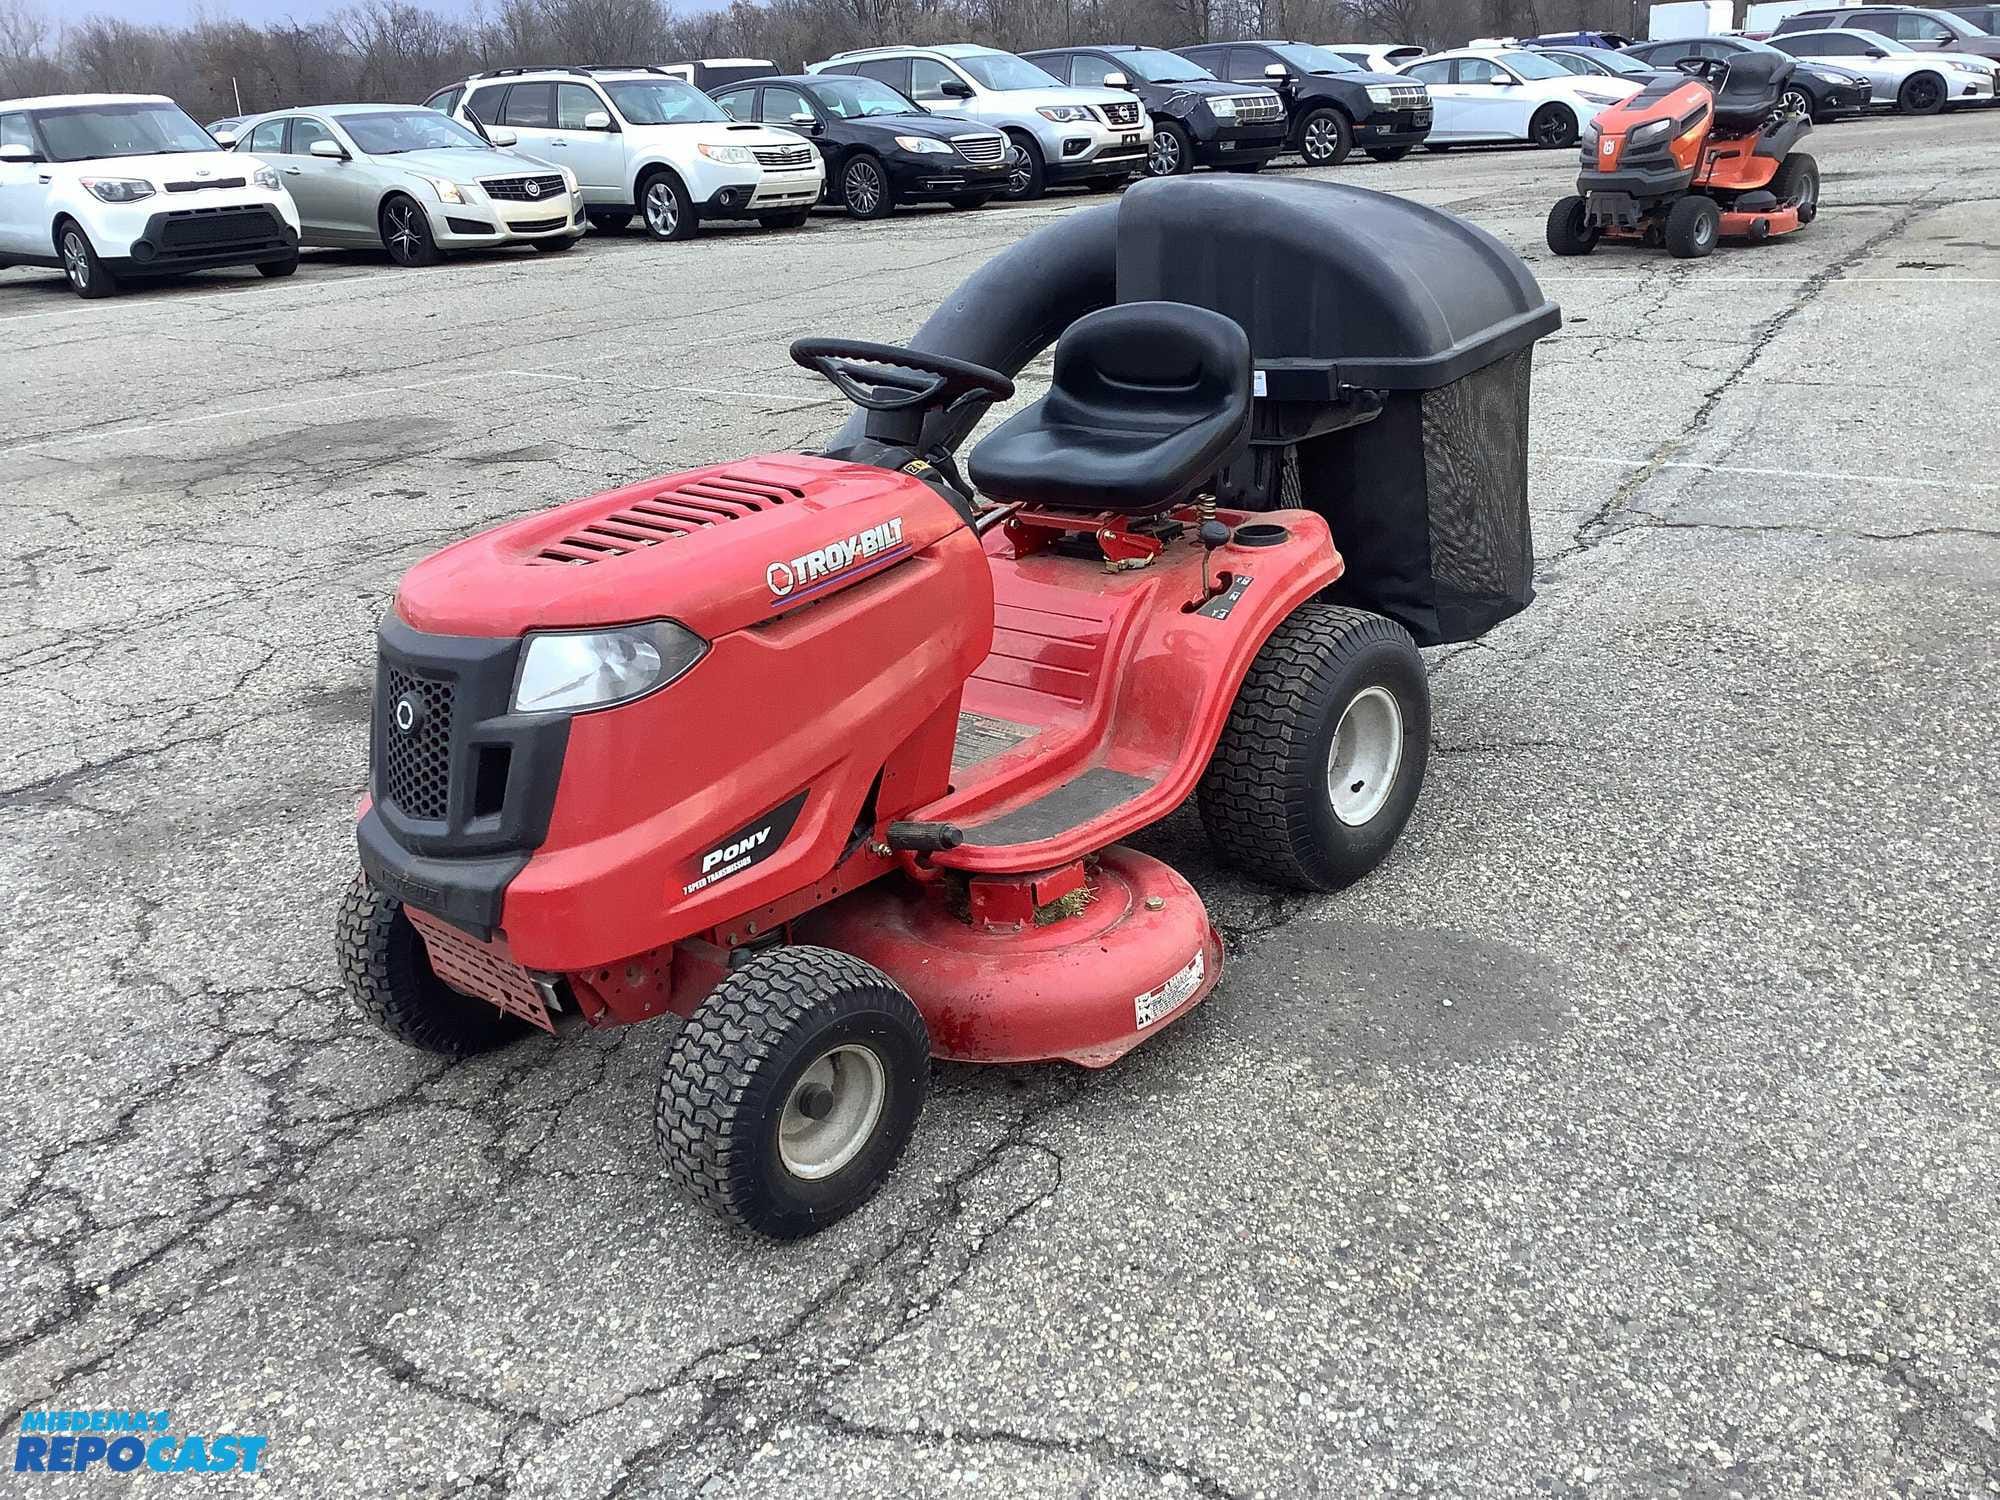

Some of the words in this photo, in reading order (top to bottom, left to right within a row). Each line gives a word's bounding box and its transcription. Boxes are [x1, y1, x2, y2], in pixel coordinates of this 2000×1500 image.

[790, 516, 904, 586] TROY-BILT
[702, 826, 771, 873] PONY
[687, 877, 707, 893] SPEED
[706, 855, 752, 884] TRANSMISSION
